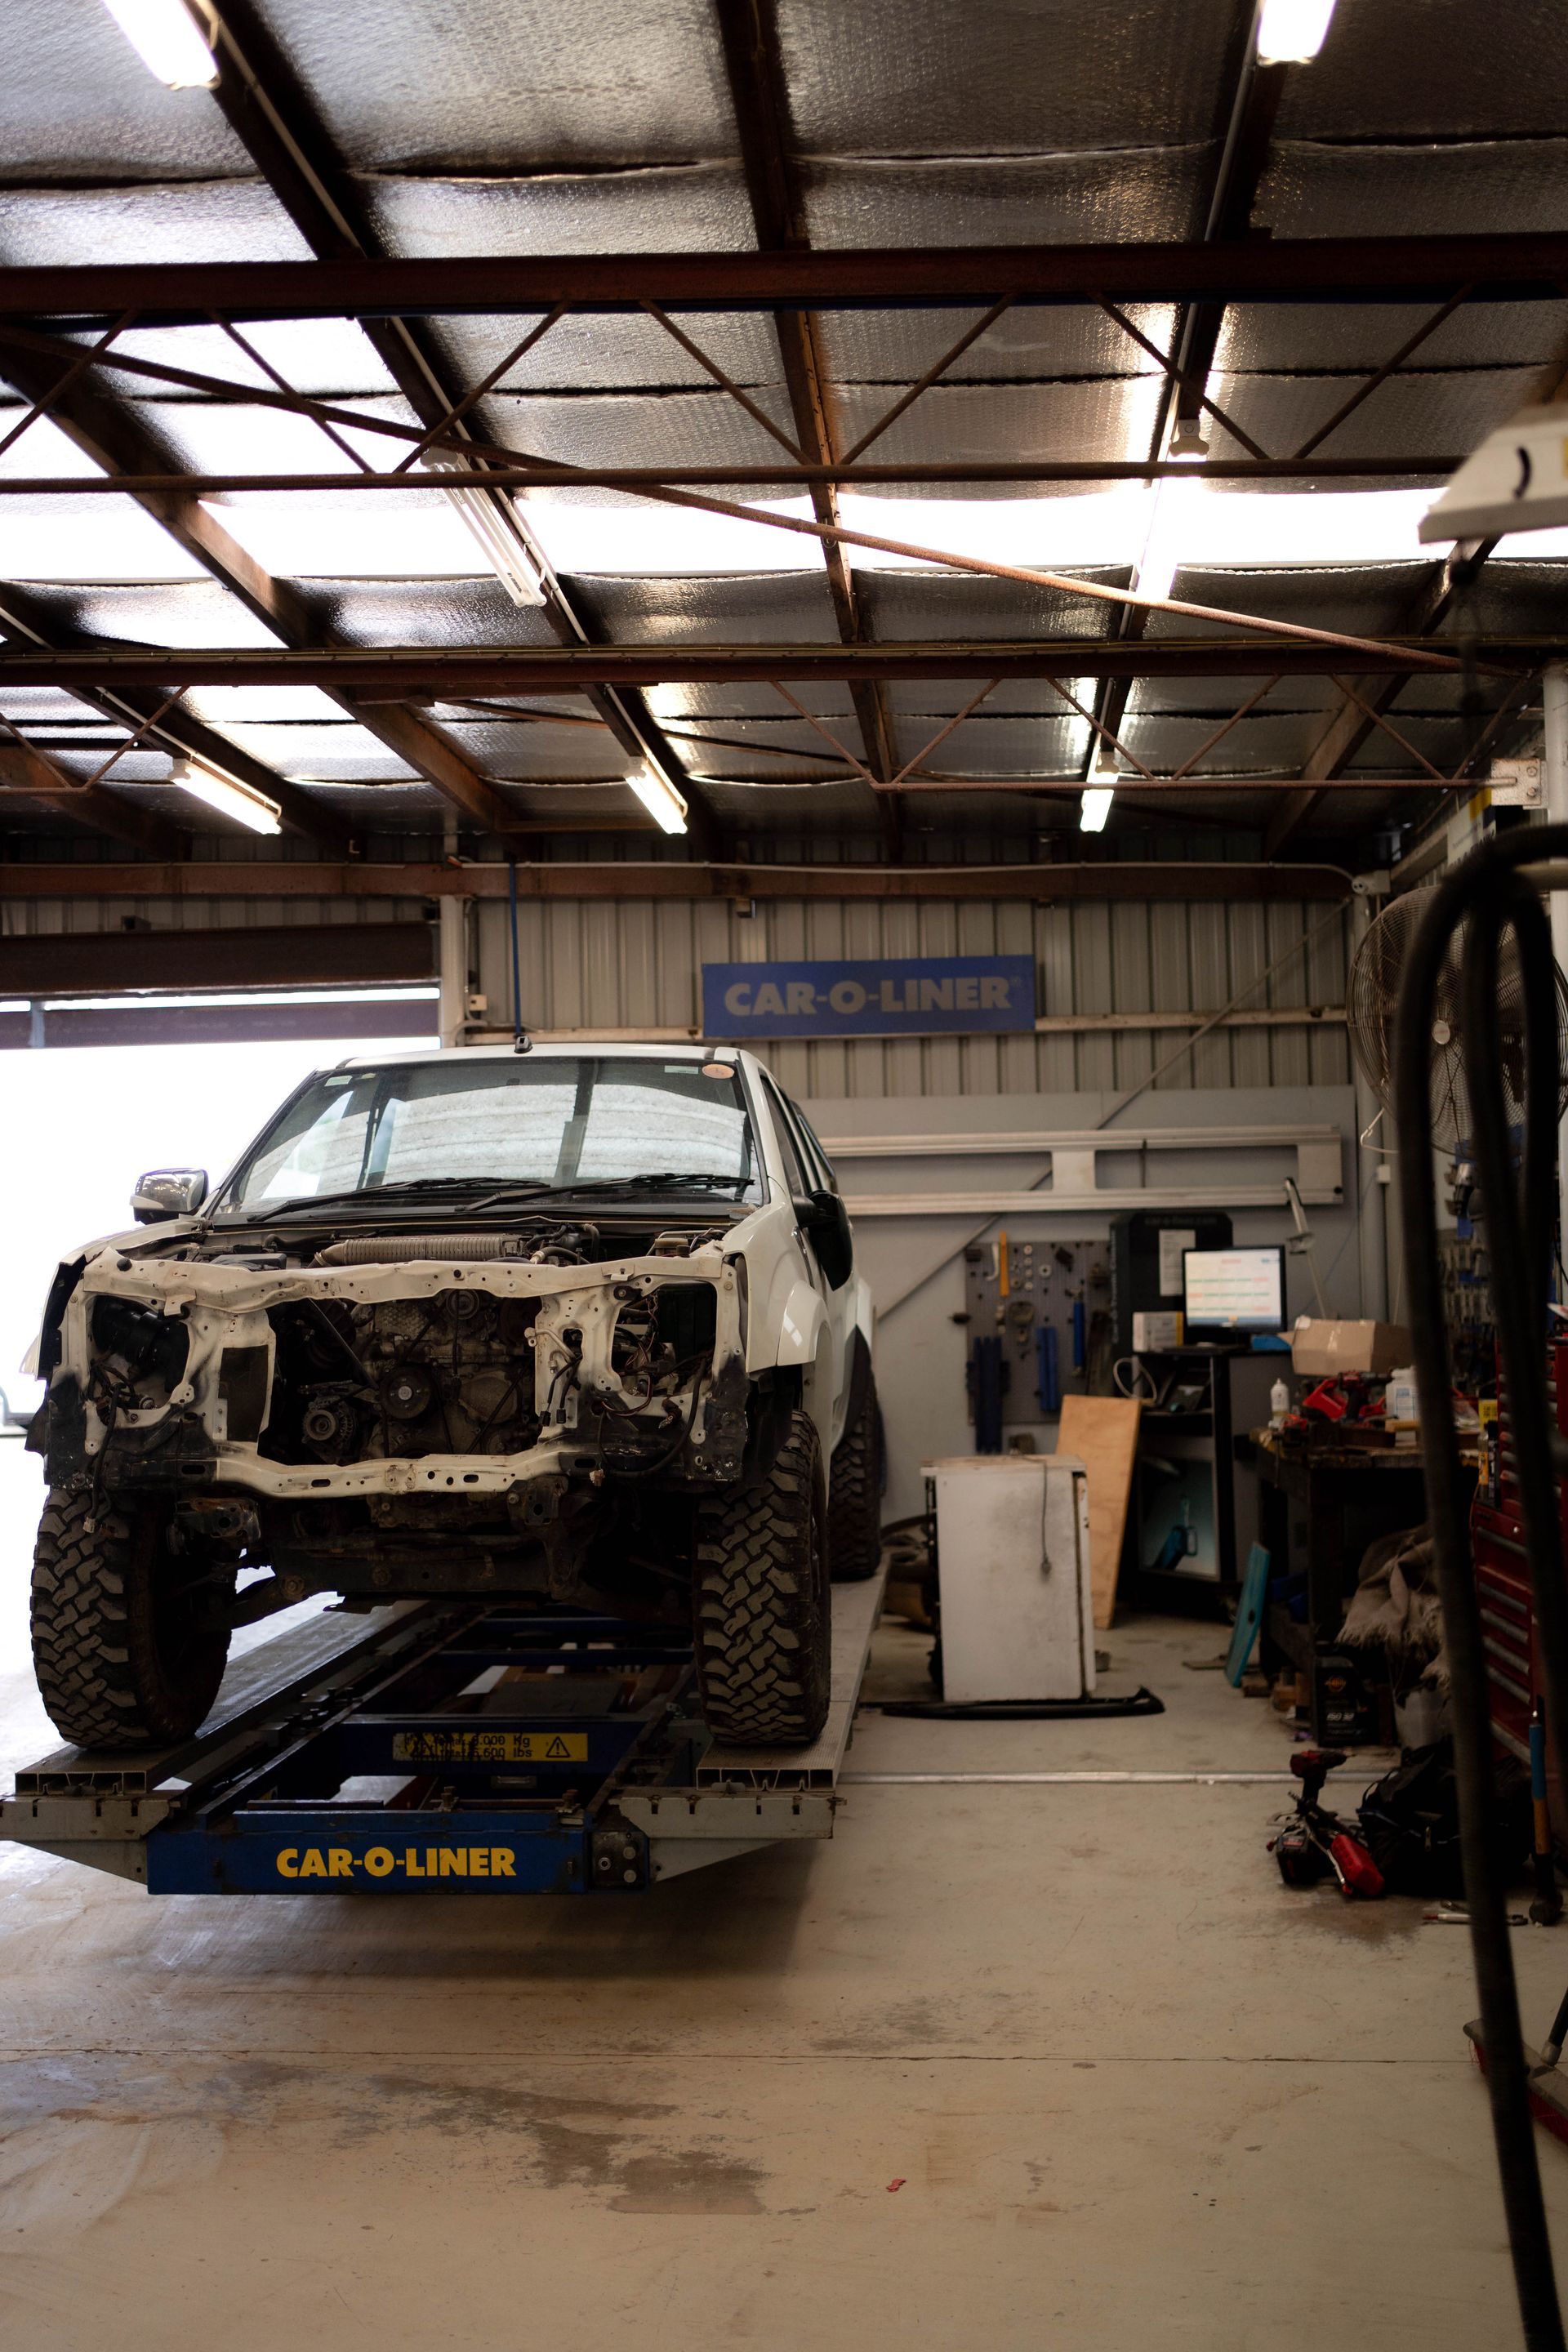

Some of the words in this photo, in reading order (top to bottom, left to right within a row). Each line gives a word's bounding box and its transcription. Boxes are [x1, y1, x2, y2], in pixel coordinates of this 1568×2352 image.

[724, 977, 1012, 1017] CAR-O-LINER
[514, 1735, 530, 1748] Kg
[514, 1747, 532, 1757] lbs
[276, 1846, 517, 1878] CAR-O-LINER
